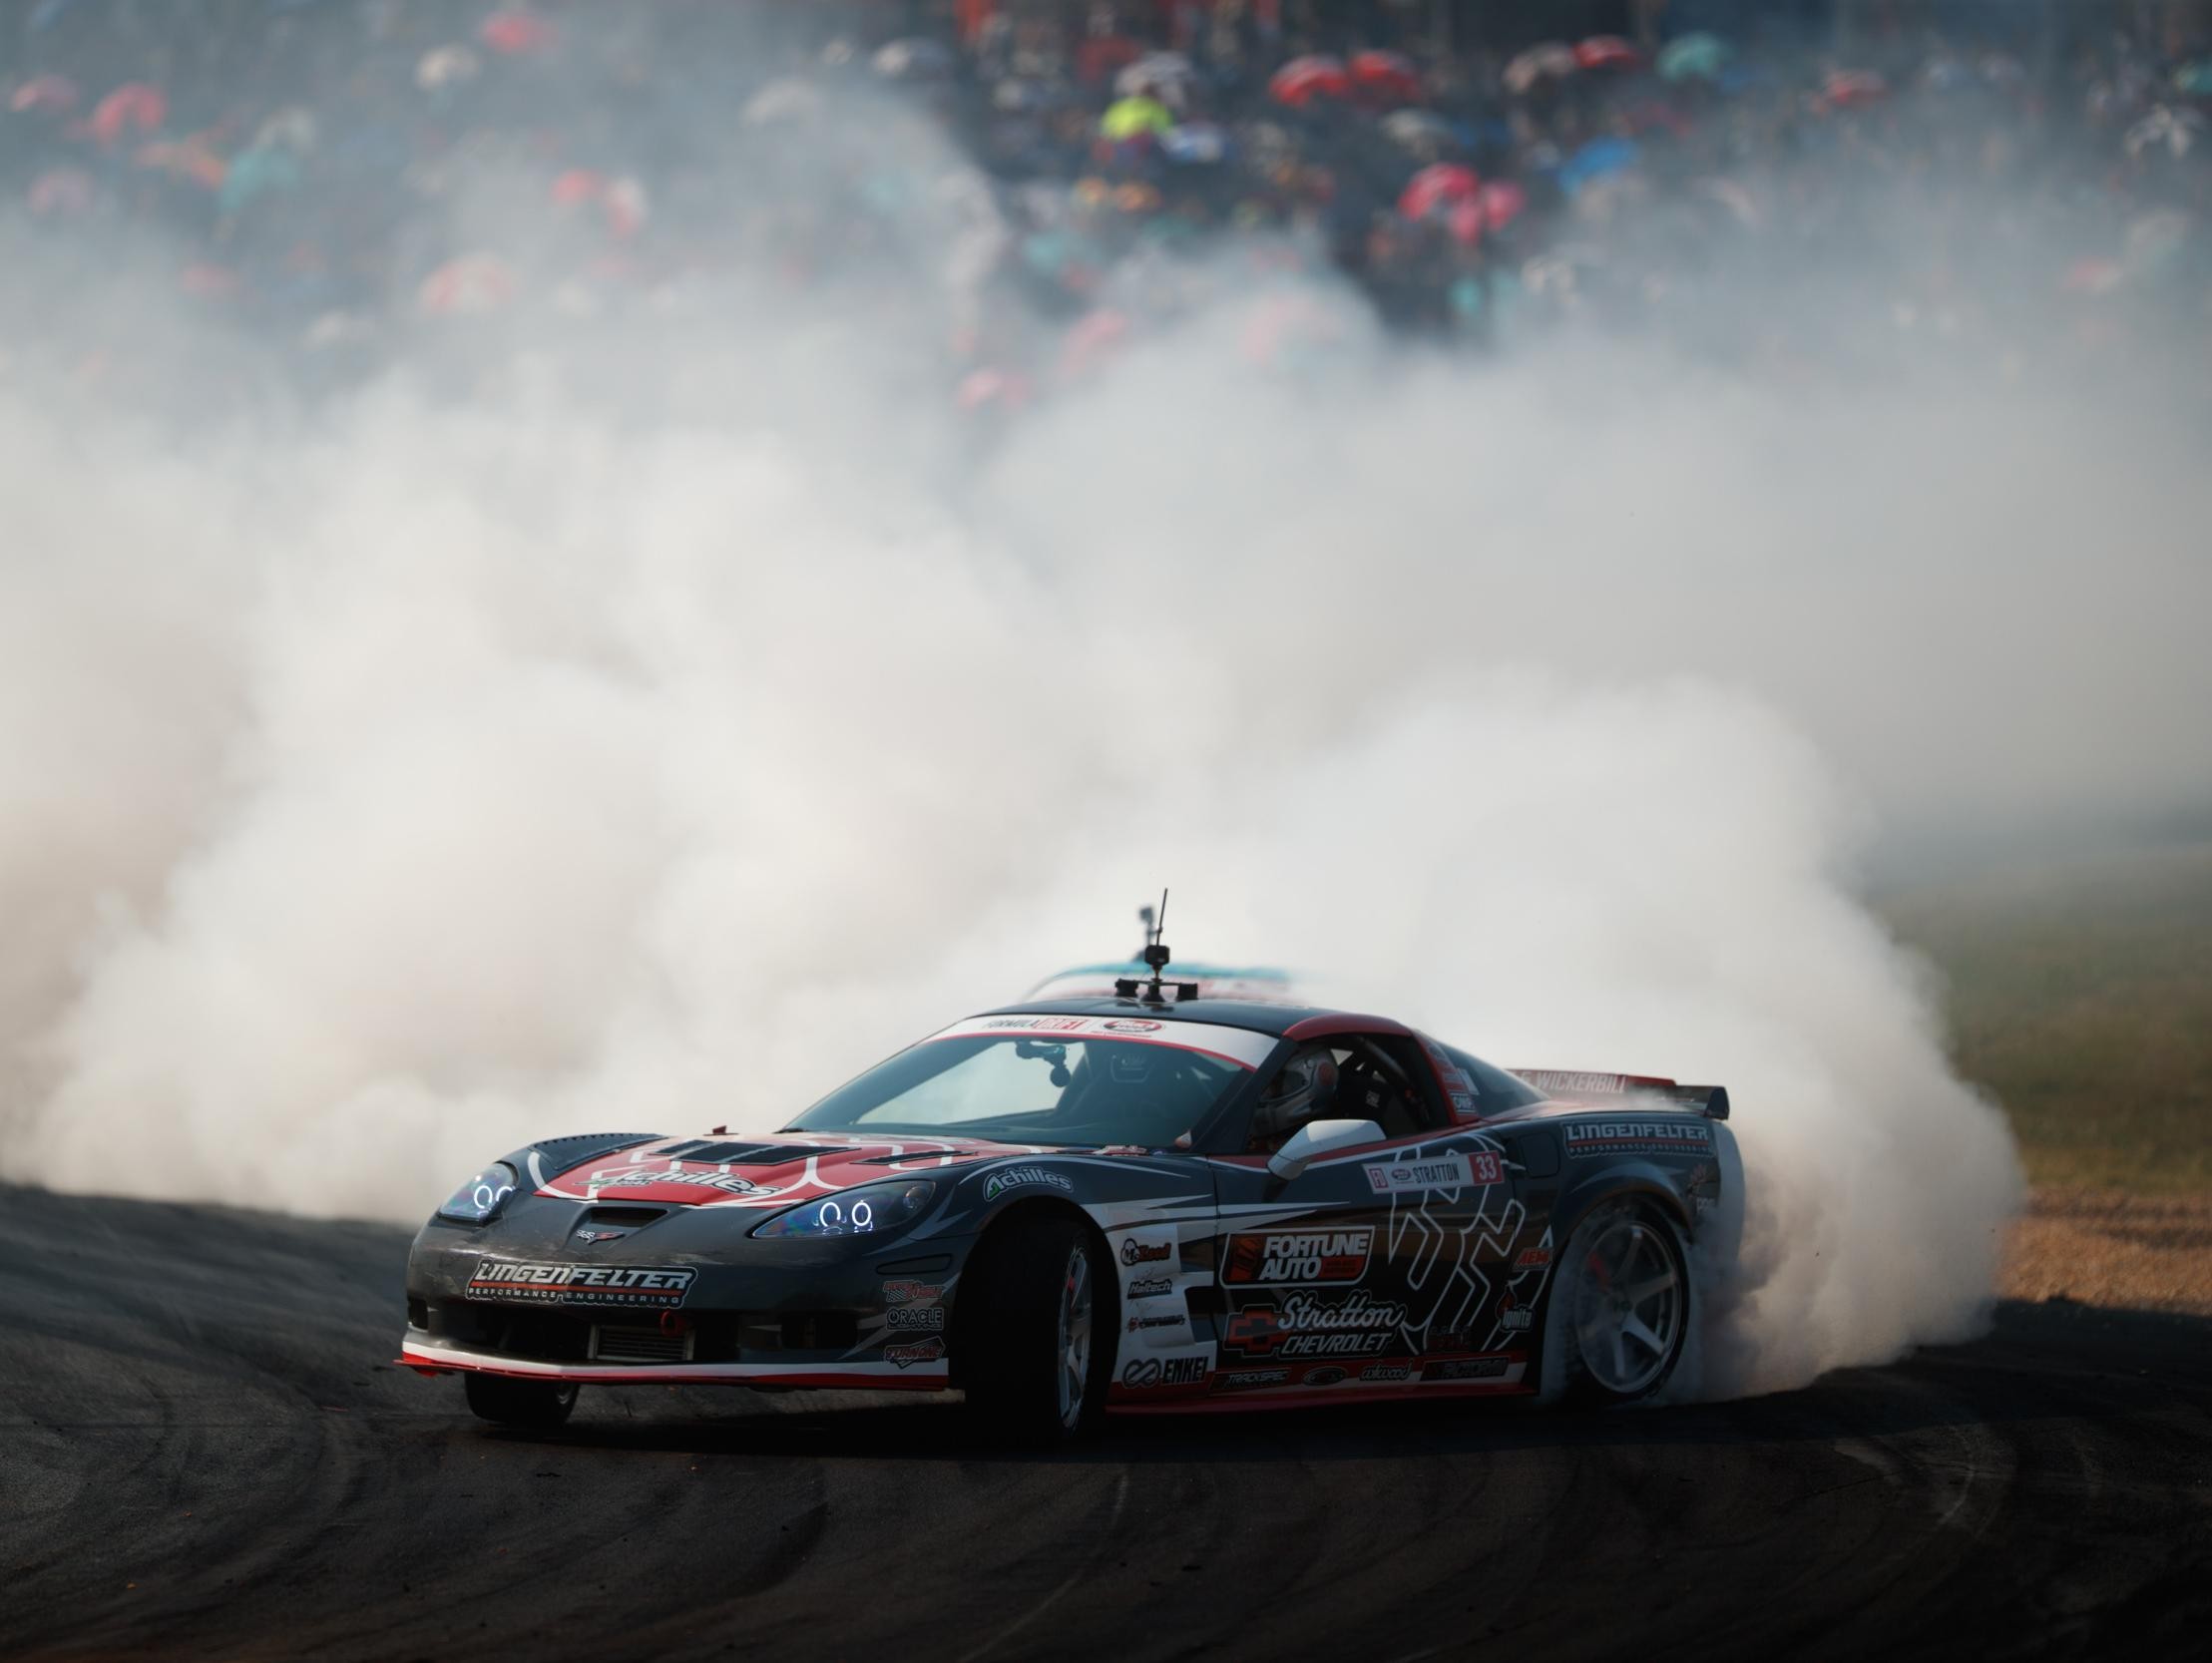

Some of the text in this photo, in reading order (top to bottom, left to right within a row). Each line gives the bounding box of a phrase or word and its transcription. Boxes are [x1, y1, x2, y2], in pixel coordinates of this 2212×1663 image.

[1536, 1070, 1627, 1093] WICKERBILL
[1566, 1123, 1709, 1140] LINGENFELTER
[1413, 1163, 1461, 1184] STRATTON
[1477, 1155, 1497, 1180] 33
[985, 1168, 1073, 1200] Achilles
[1262, 1233, 1370, 1258] FORTUNE
[1257, 1257, 1322, 1281] AUTO
[1517, 1250, 1549, 1265] AEM
[477, 1262, 692, 1290] LINGENFELTER
[468, 1287, 680, 1304] PERFORMANCE ENGINEERING
[1127, 1279, 1172, 1297] Haltech
[888, 1308, 943, 1325] ORACLE
[1277, 1296, 1404, 1330] Stratton
[1281, 1332, 1393, 1355] CHEVROLET
[1163, 1358, 1208, 1384] ENKEI
